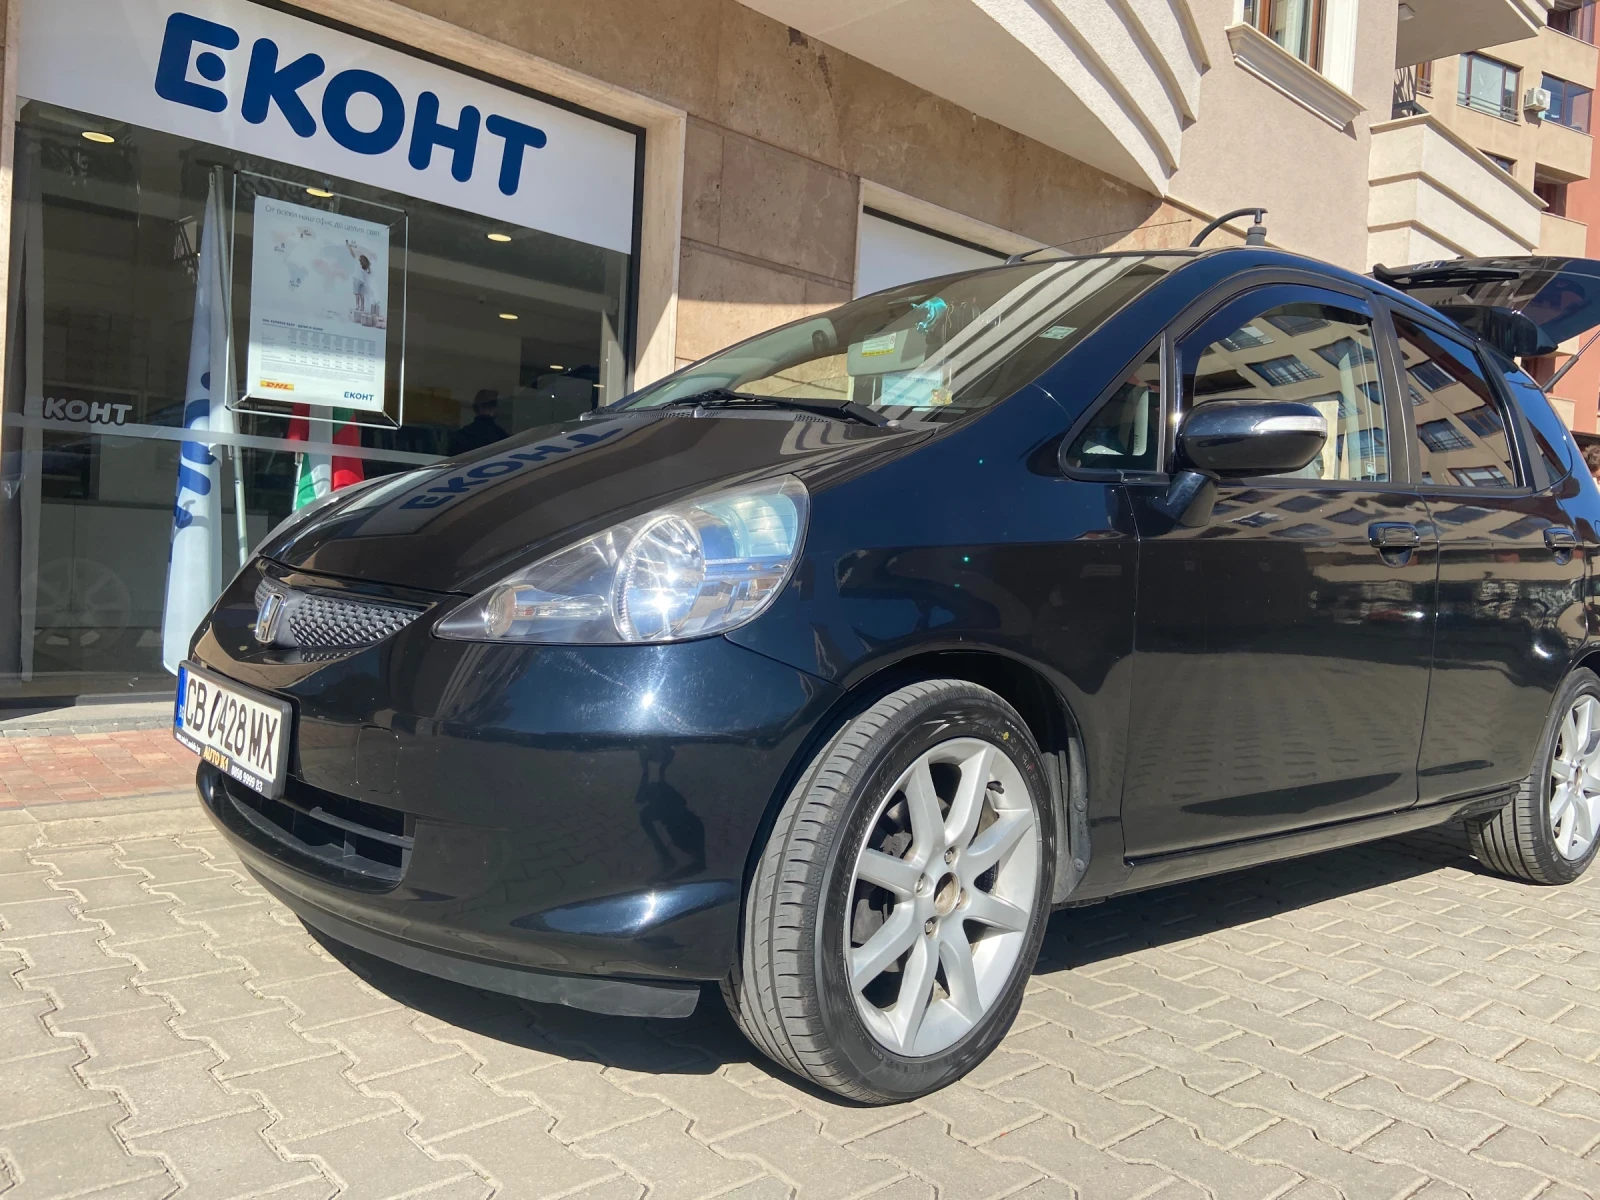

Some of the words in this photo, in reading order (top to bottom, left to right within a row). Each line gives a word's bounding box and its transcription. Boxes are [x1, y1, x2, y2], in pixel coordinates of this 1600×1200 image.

[155, 12, 547, 196] ЕКОНТ
[265, 204, 274, 213] От
[276, 207, 298, 219] всеки
[299, 213, 314, 223] наш
[315, 217, 334, 227] офис
[334, 221, 344, 230] до
[344, 223, 365, 235] целия
[265, 381, 290, 390] DHL
[344, 391, 375, 401] ЕКОНТ
[28, 395, 133, 425] КОНТ
[185, 677, 208, 731] CB
[247, 708, 278, 775] MX
[203, 744, 220, 766] AUTO
